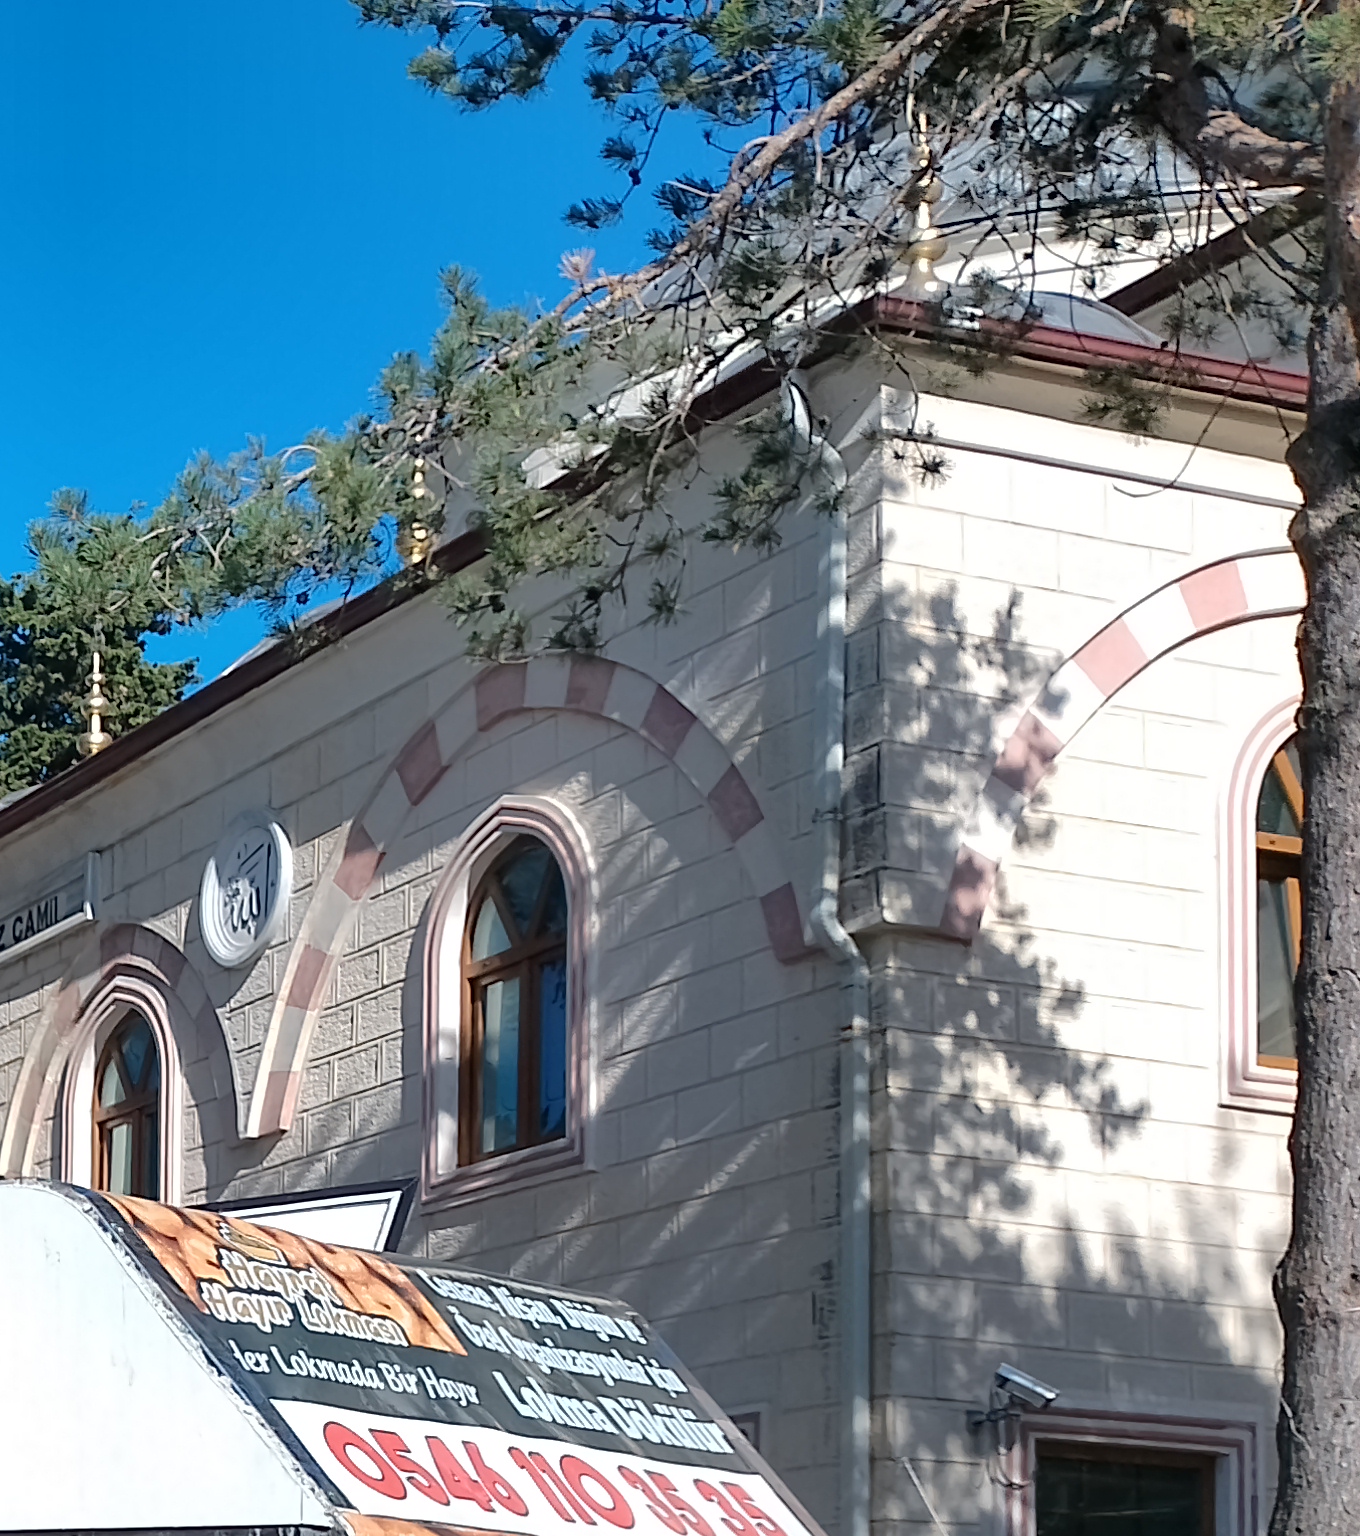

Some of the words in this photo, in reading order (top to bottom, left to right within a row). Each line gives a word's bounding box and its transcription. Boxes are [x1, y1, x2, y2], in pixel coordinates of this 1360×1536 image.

[296, 1297, 410, 1347] Lokması
[417, 1269, 502, 1313] Cenaze,
[270, 1346, 384, 1389] Lokmada
[379, 1363, 418, 1395] Bir
[416, 1367, 479, 1407] Hayır
[446, 1305, 510, 1353] Özel
[501, 1324, 653, 1386] Organizasyonlar
[492, 1371, 619, 1435] Lokma
[597, 1395, 735, 1454] Dökülür
[322, 1421, 529, 1517] 0546
[508, 1447, 635, 1529] 110
